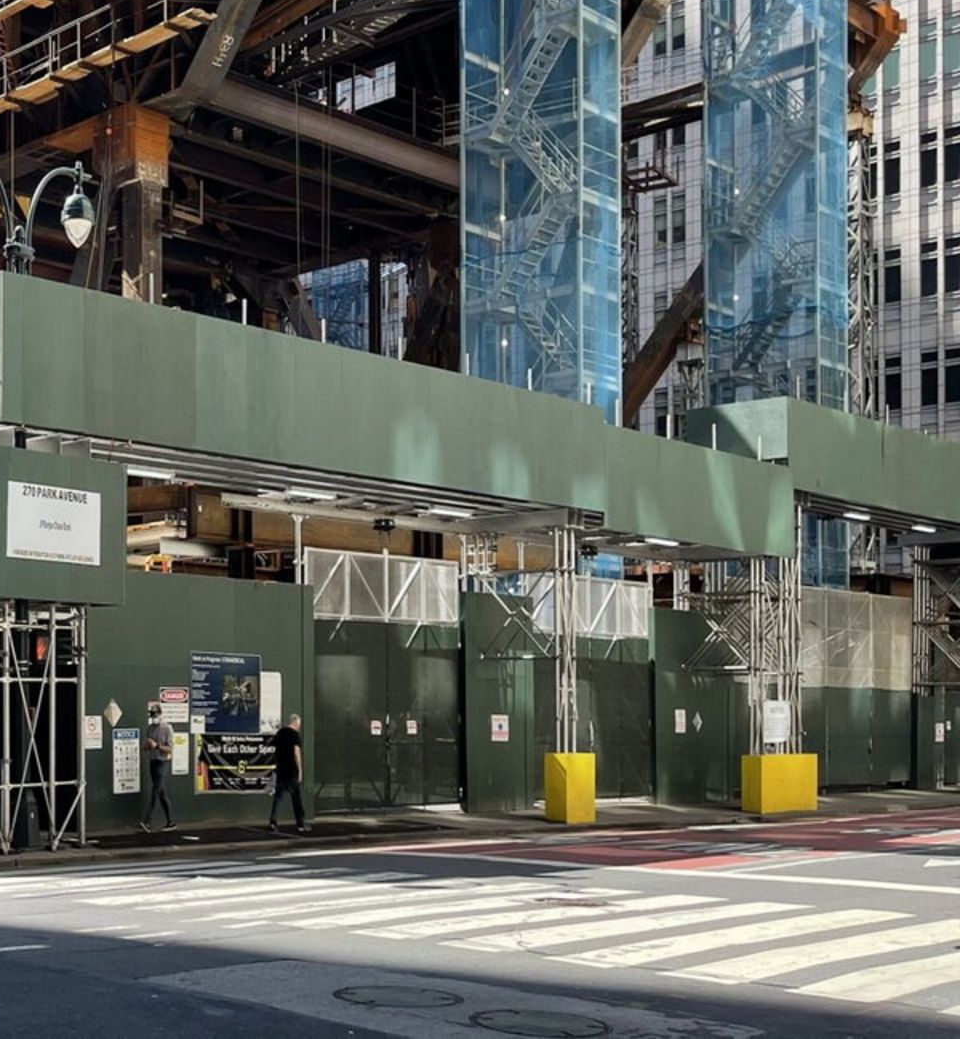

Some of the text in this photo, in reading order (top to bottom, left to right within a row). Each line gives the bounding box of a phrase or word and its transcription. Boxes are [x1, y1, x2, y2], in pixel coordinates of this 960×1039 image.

[22, 485, 88, 504] 270 PARK AVENUE
